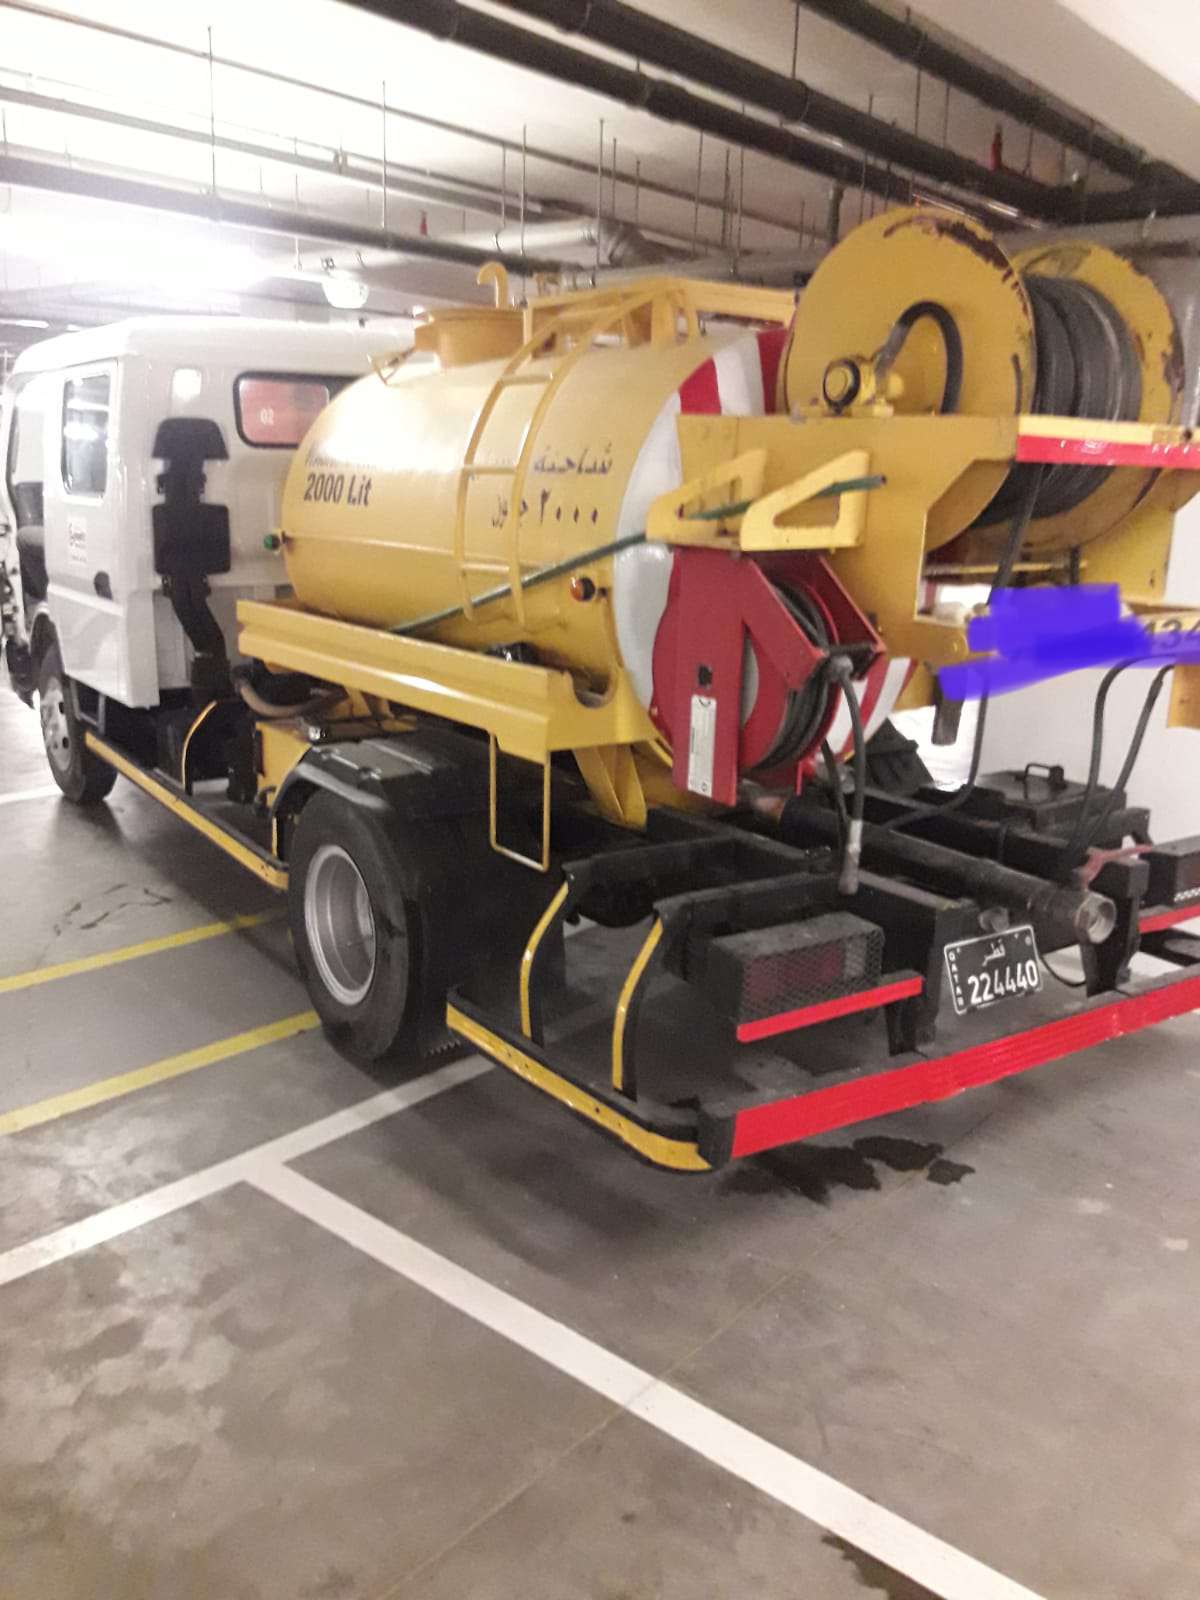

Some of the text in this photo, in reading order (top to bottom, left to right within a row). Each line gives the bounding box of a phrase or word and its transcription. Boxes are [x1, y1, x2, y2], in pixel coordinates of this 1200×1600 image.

[303, 471, 373, 508] 2000 Lit
[982, 938, 1006, 967] قطر
[967, 959, 1039, 1005] 224440
